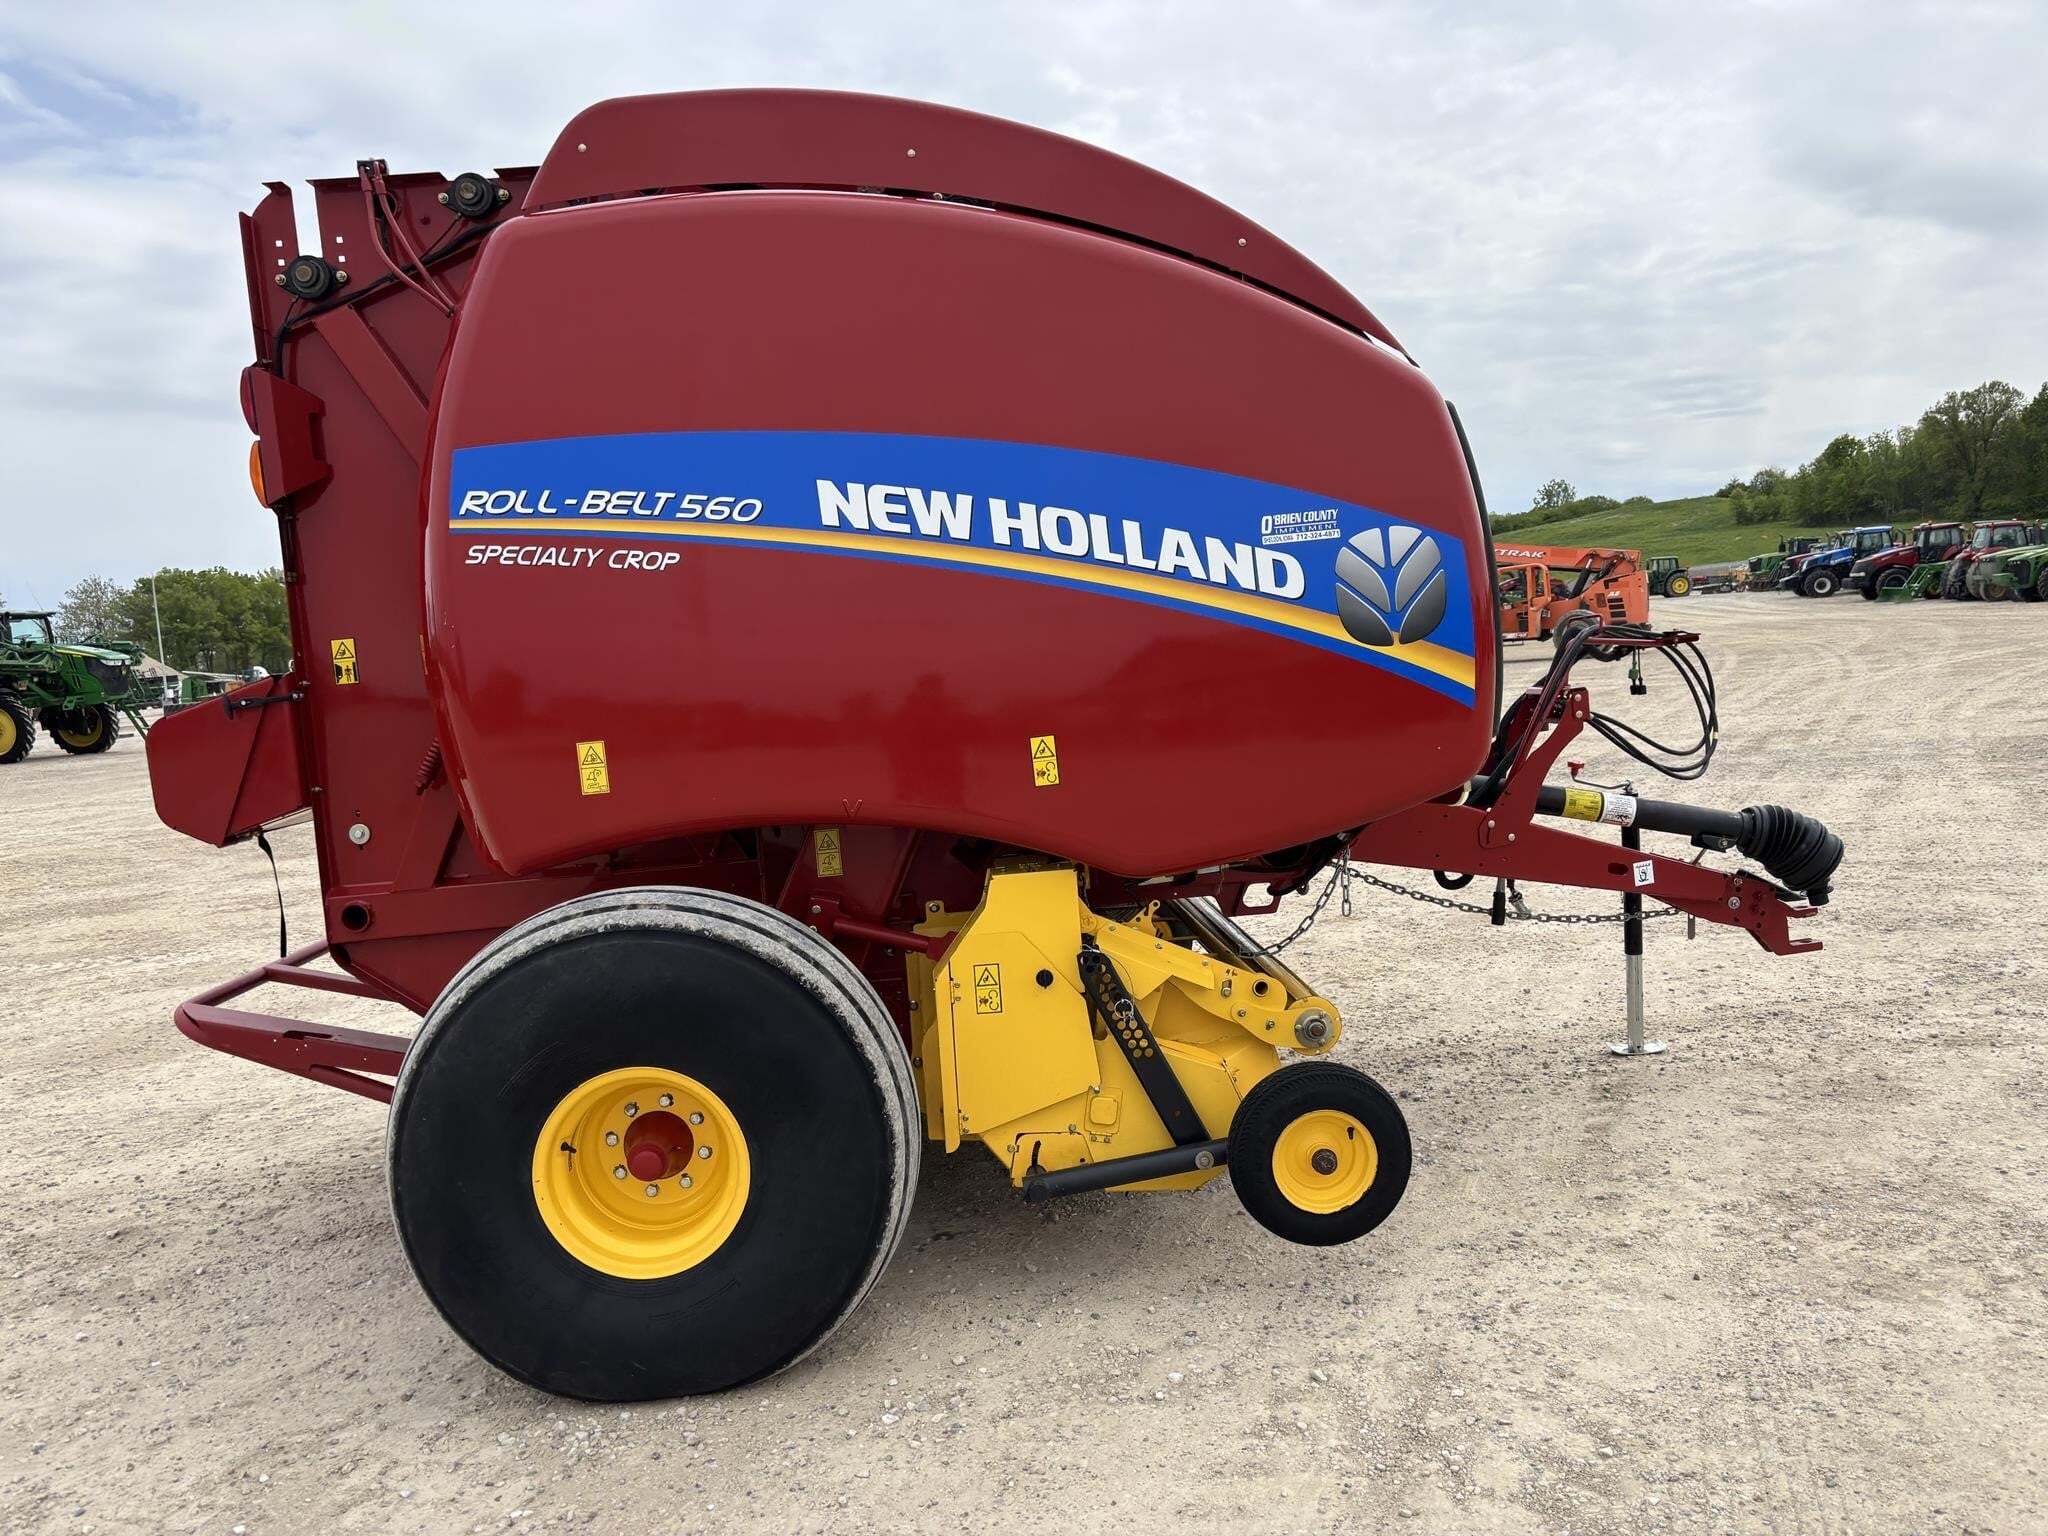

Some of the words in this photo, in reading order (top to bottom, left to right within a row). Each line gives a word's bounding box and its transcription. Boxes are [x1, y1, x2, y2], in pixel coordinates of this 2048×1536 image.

[676, 496, 763, 522] 560
[1261, 512, 1302, 534] O'BRIEN
[1303, 509, 1339, 522] COUNTY
[816, 479, 973, 540] NEW
[988, 497, 1305, 599] HOLLAND
[1275, 523, 1337, 534] IMPLEMENT
[465, 545, 603, 567] SPECIALTY
[608, 550, 680, 571] CROP
